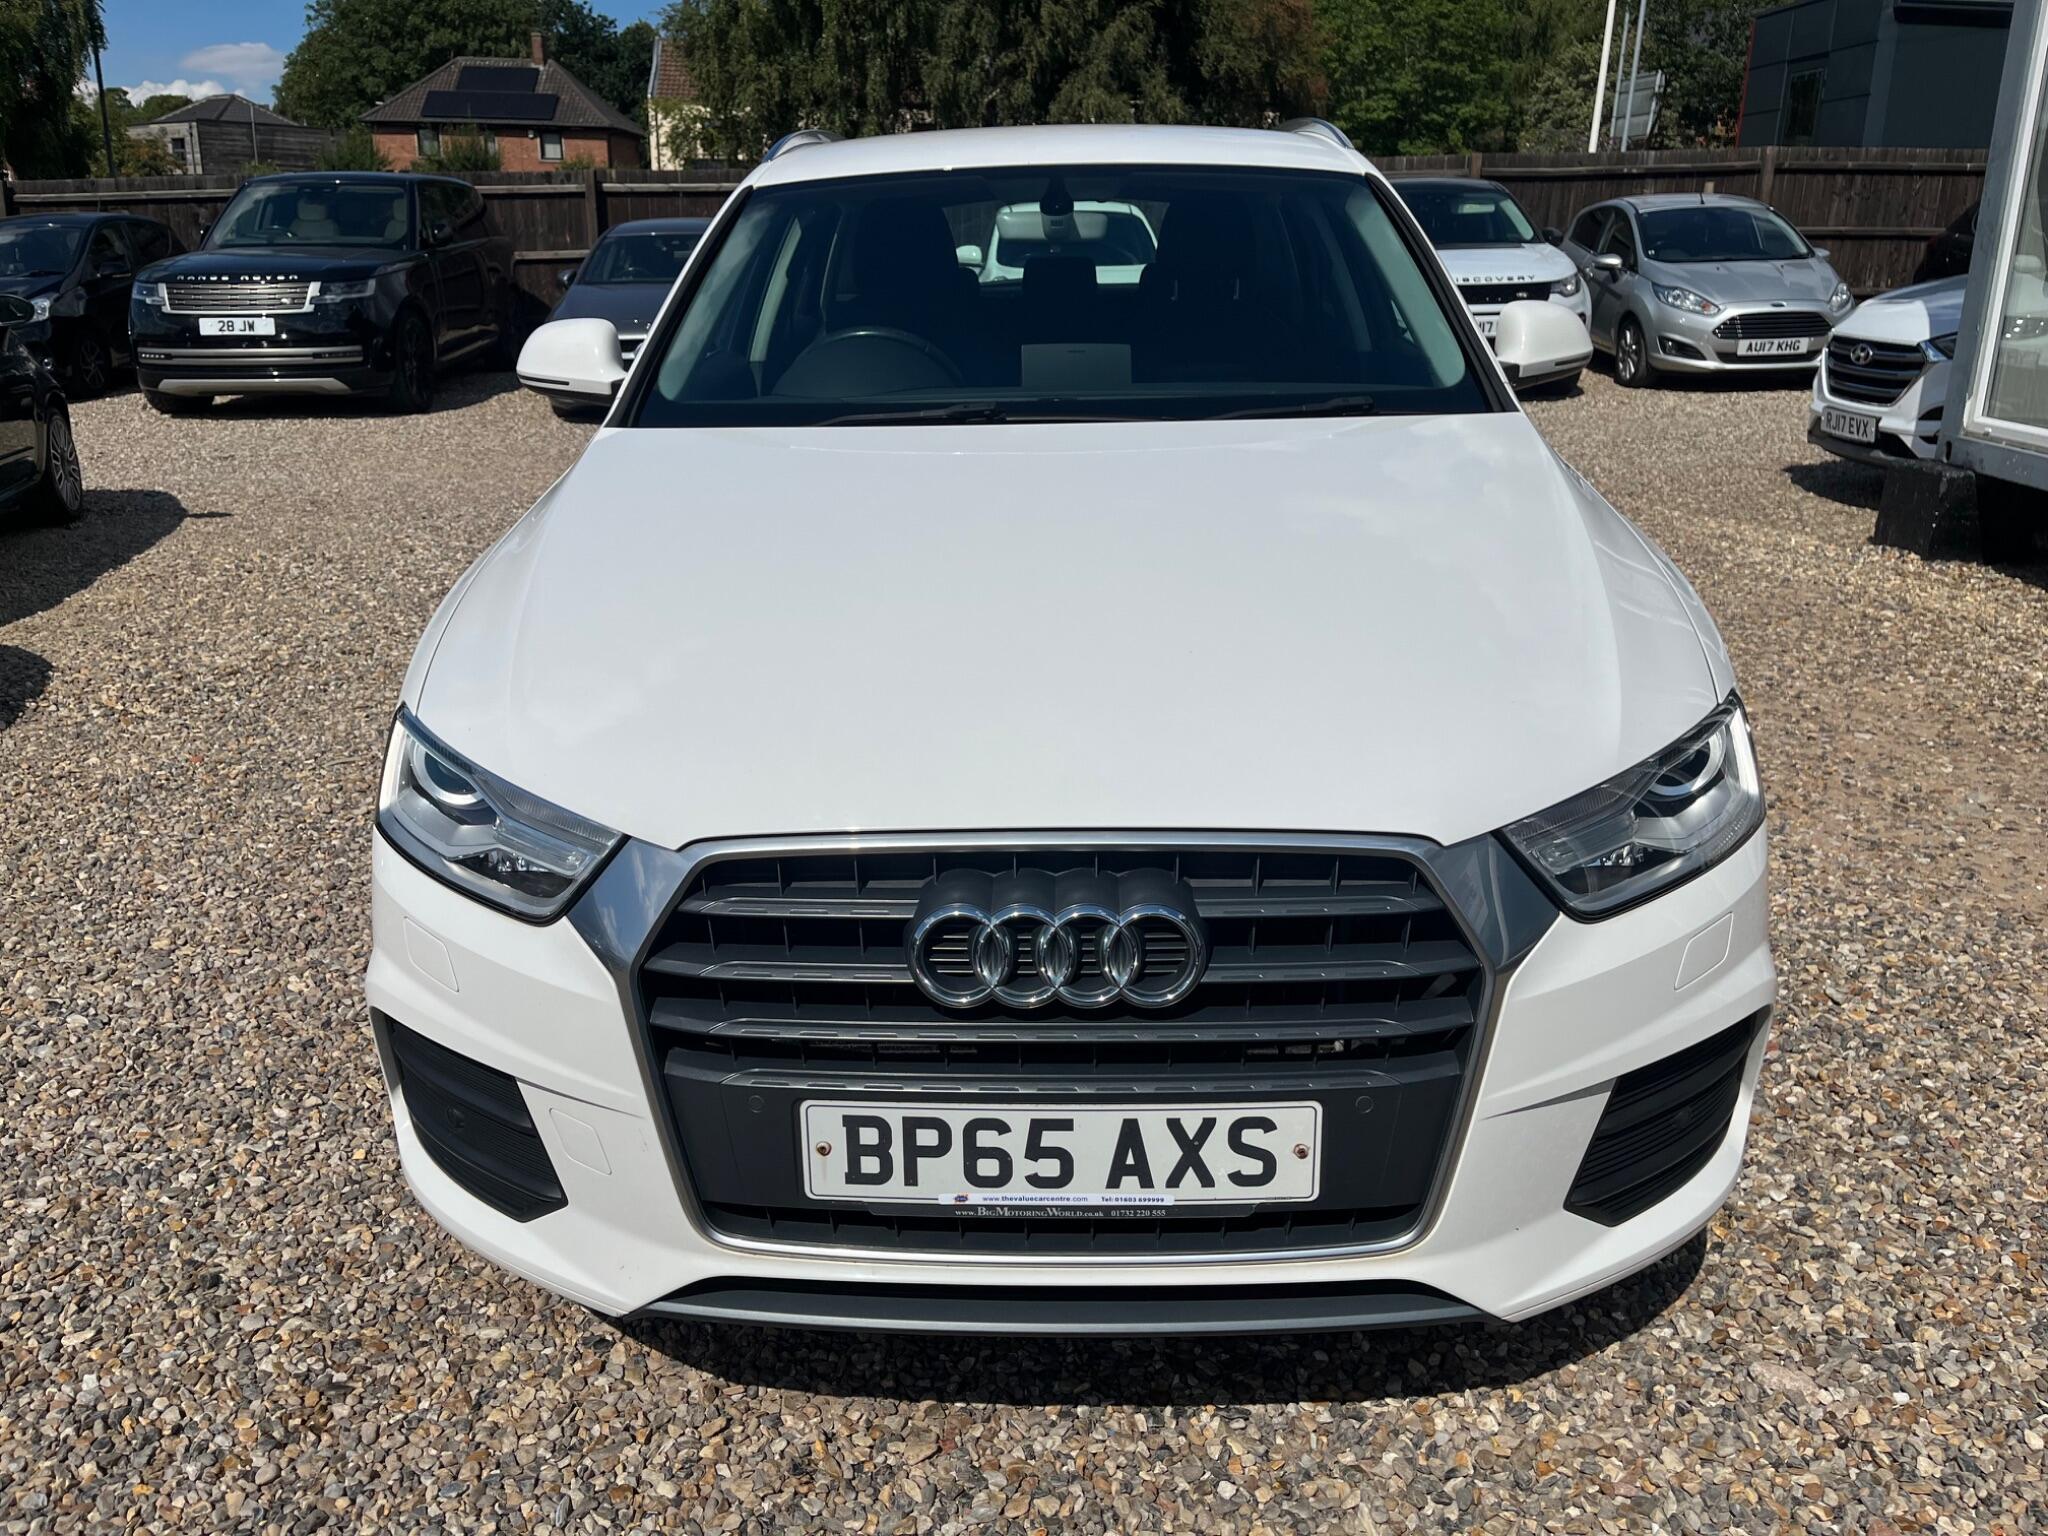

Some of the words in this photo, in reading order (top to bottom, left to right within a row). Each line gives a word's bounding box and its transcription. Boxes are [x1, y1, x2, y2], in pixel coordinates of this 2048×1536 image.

[1455, 275, 1535, 283] ISCOVERY
[218, 320, 235, 332] 28
[239, 320, 255, 332] JW
[1746, 341, 1774, 353] AU17
[1776, 339, 1801, 352] KHG
[1826, 411, 1847, 433] RJ17
[1848, 416, 1869, 438] EVX
[841, 1113, 1075, 1189] BP65
[1105, 1115, 1278, 1190] AXS
[1110, 1209, 1134, 1217] 01732
[1136, 1209, 1150, 1217] 220
[1151, 1209, 1166, 1217] 555
